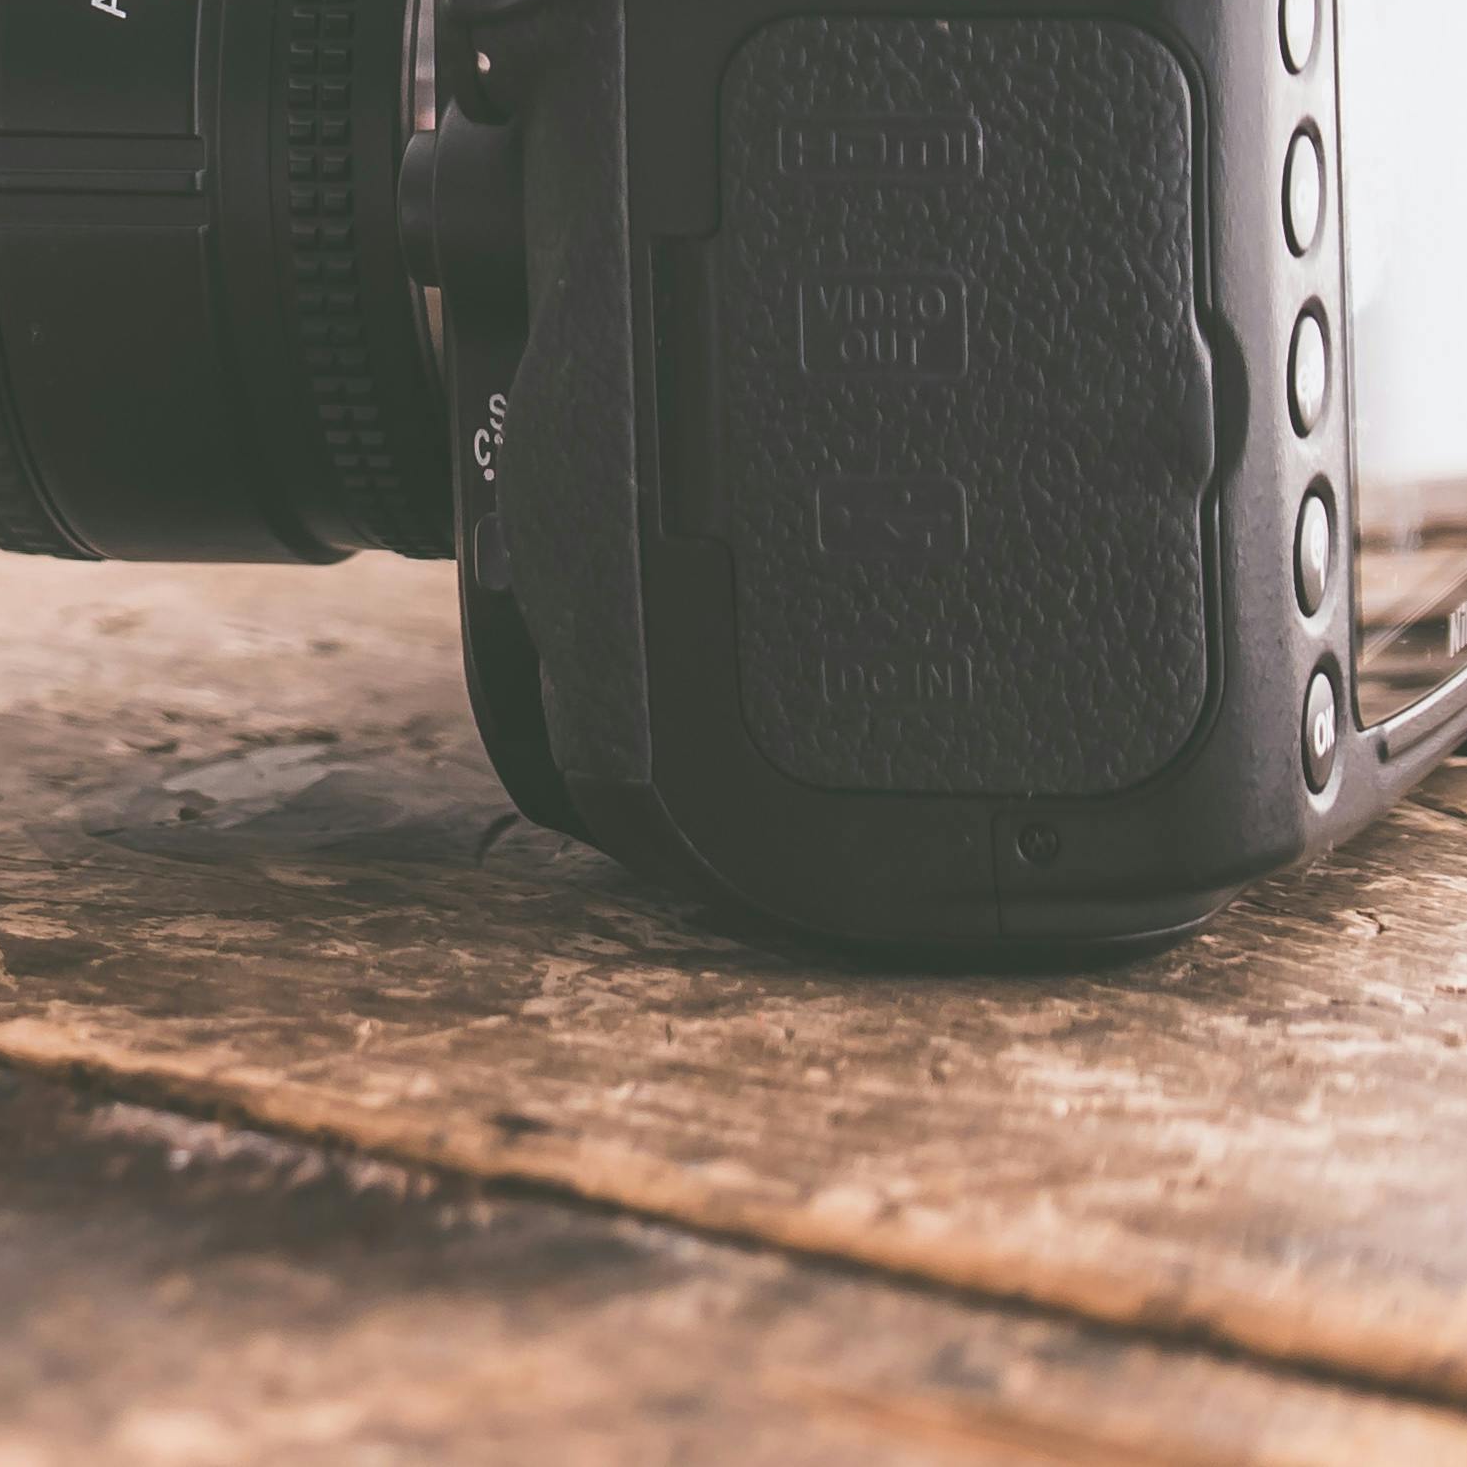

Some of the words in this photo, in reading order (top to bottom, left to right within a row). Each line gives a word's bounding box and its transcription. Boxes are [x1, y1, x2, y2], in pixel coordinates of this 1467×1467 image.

[817, 283, 948, 325] VIDEO
[838, 326, 926, 369] OUT
[1314, 703, 1335, 758] OK
